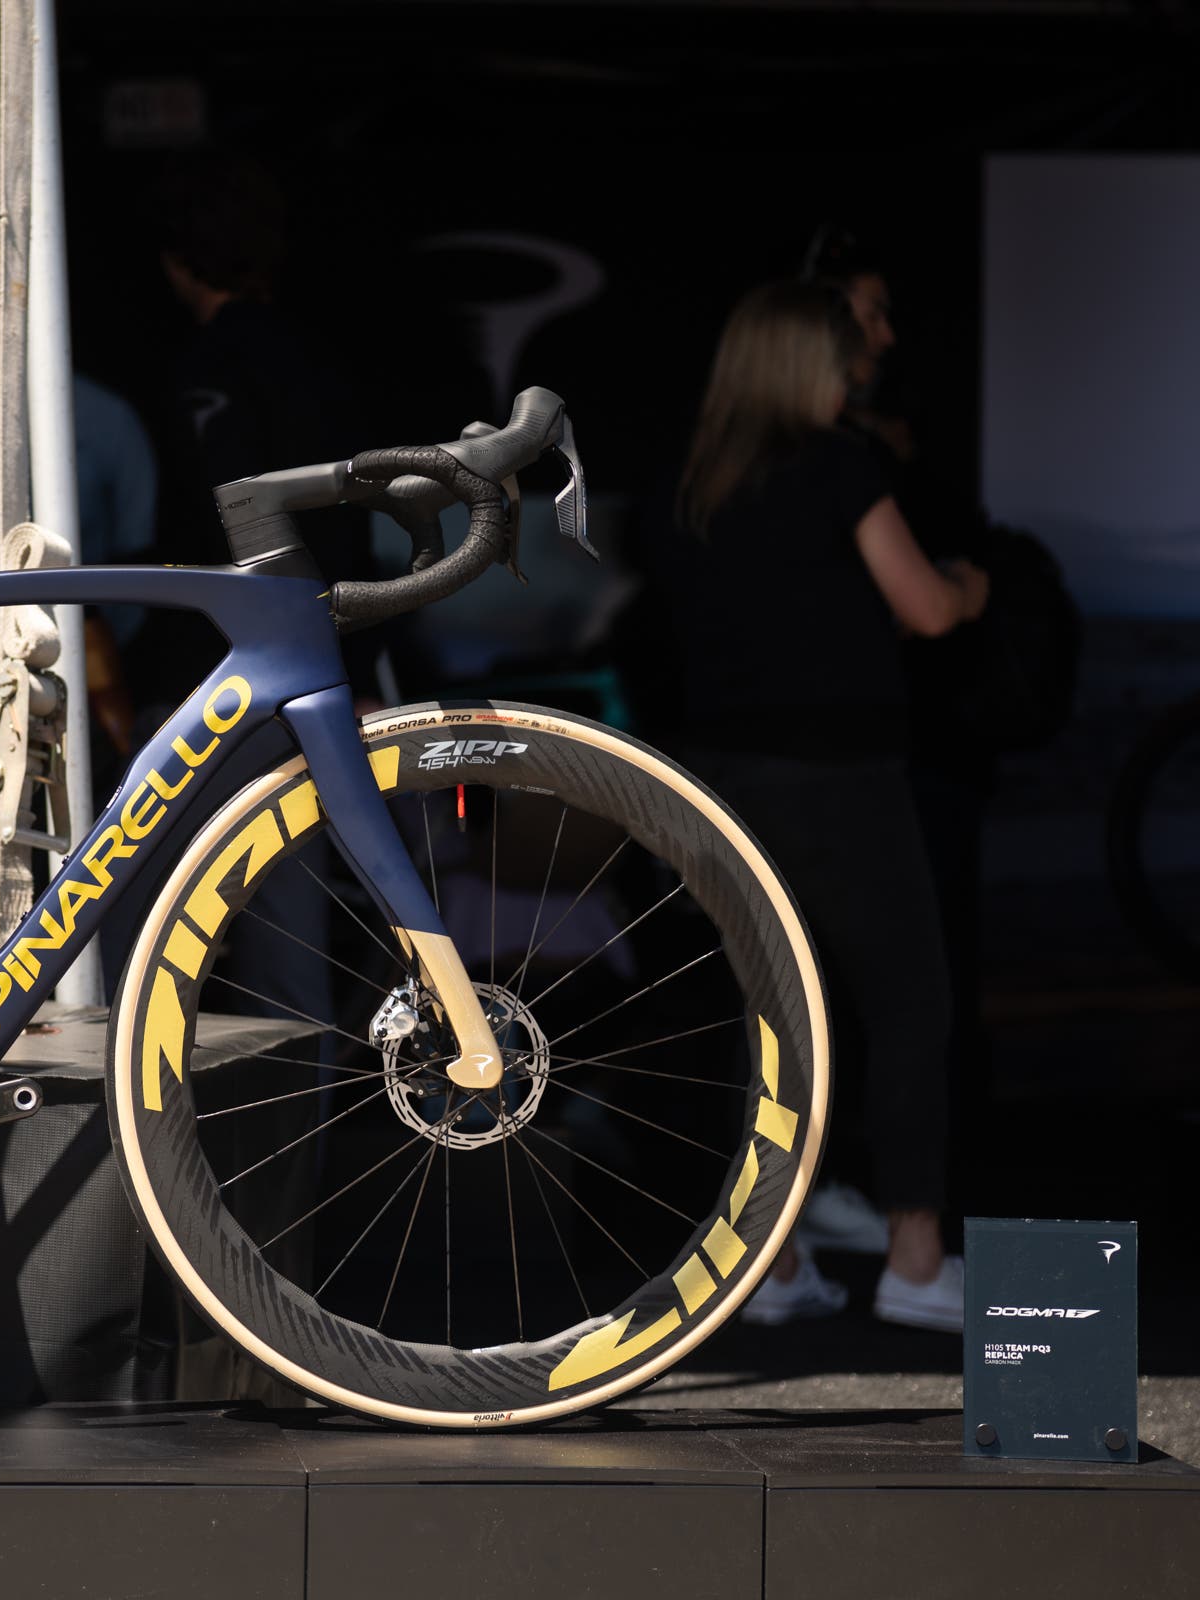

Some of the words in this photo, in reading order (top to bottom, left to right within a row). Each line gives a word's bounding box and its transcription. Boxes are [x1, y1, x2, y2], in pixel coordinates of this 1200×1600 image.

[387, 717, 437, 732] CORSA
[441, 714, 472, 723] PRO
[419, 740, 529, 760] ZIPP
[418, 756, 460, 770] 454
[460, 756, 497, 765] NSW
[986, 1306, 1065, 1318] DOGMA
[1004, 1343, 1031, 1352] TEAM
[1032, 1344, 1051, 1354] PQ3
[984, 1351, 1024, 1360] REPLICA
[473, 1412, 505, 1423] vittoria
